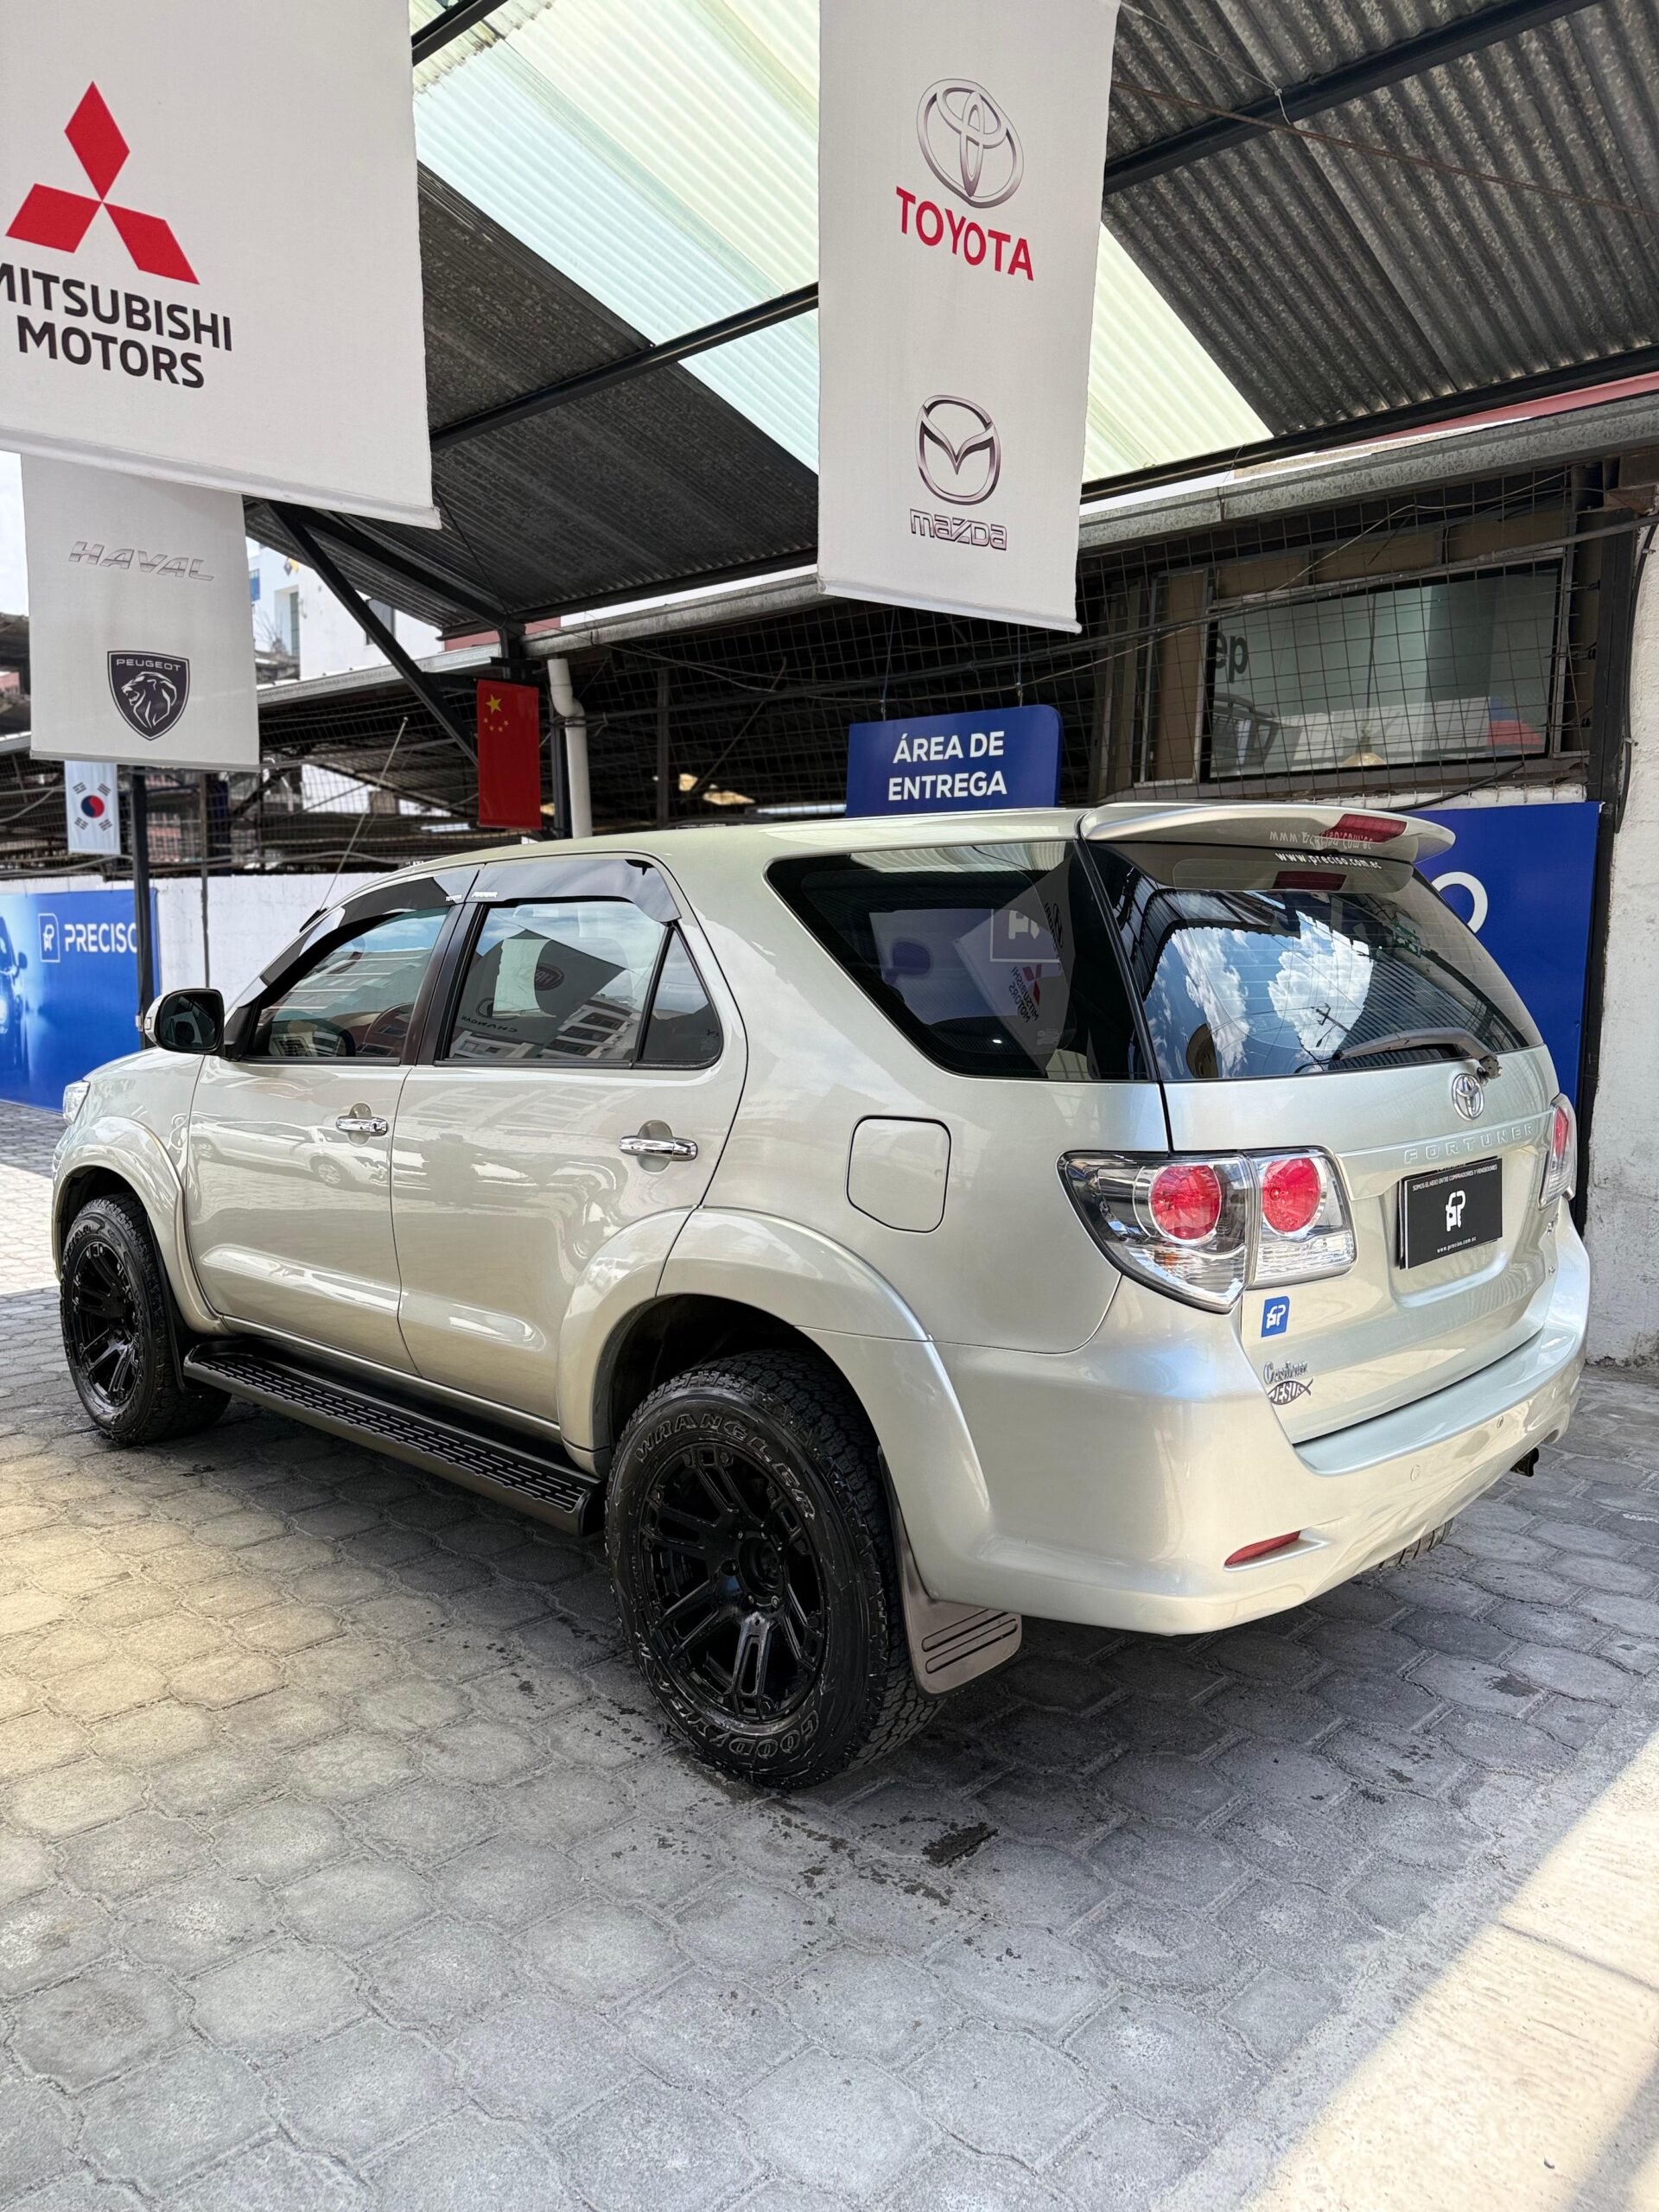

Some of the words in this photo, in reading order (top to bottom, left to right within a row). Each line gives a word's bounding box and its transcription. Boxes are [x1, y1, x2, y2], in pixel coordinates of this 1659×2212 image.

[895, 186, 1034, 282] TOYOTA
[16, 315, 205, 389] MOTORS
[68, 540, 214, 582] HAVAL
[116, 658, 182, 671] PEUGEOT
[893, 733, 964, 764] ÁREA
[969, 730, 1005, 758] DE
[888, 770, 1007, 802] ENTREGA
[1274, 852, 1382, 870] www.preciso.com.ec
[1404, 1122, 1535, 1165] FORTUNER
[1269, 1381, 1304, 1403] JESUS
[635, 1412, 816, 1521] WRANGLER
[636, 1630, 819, 1759] GOODYEAR
